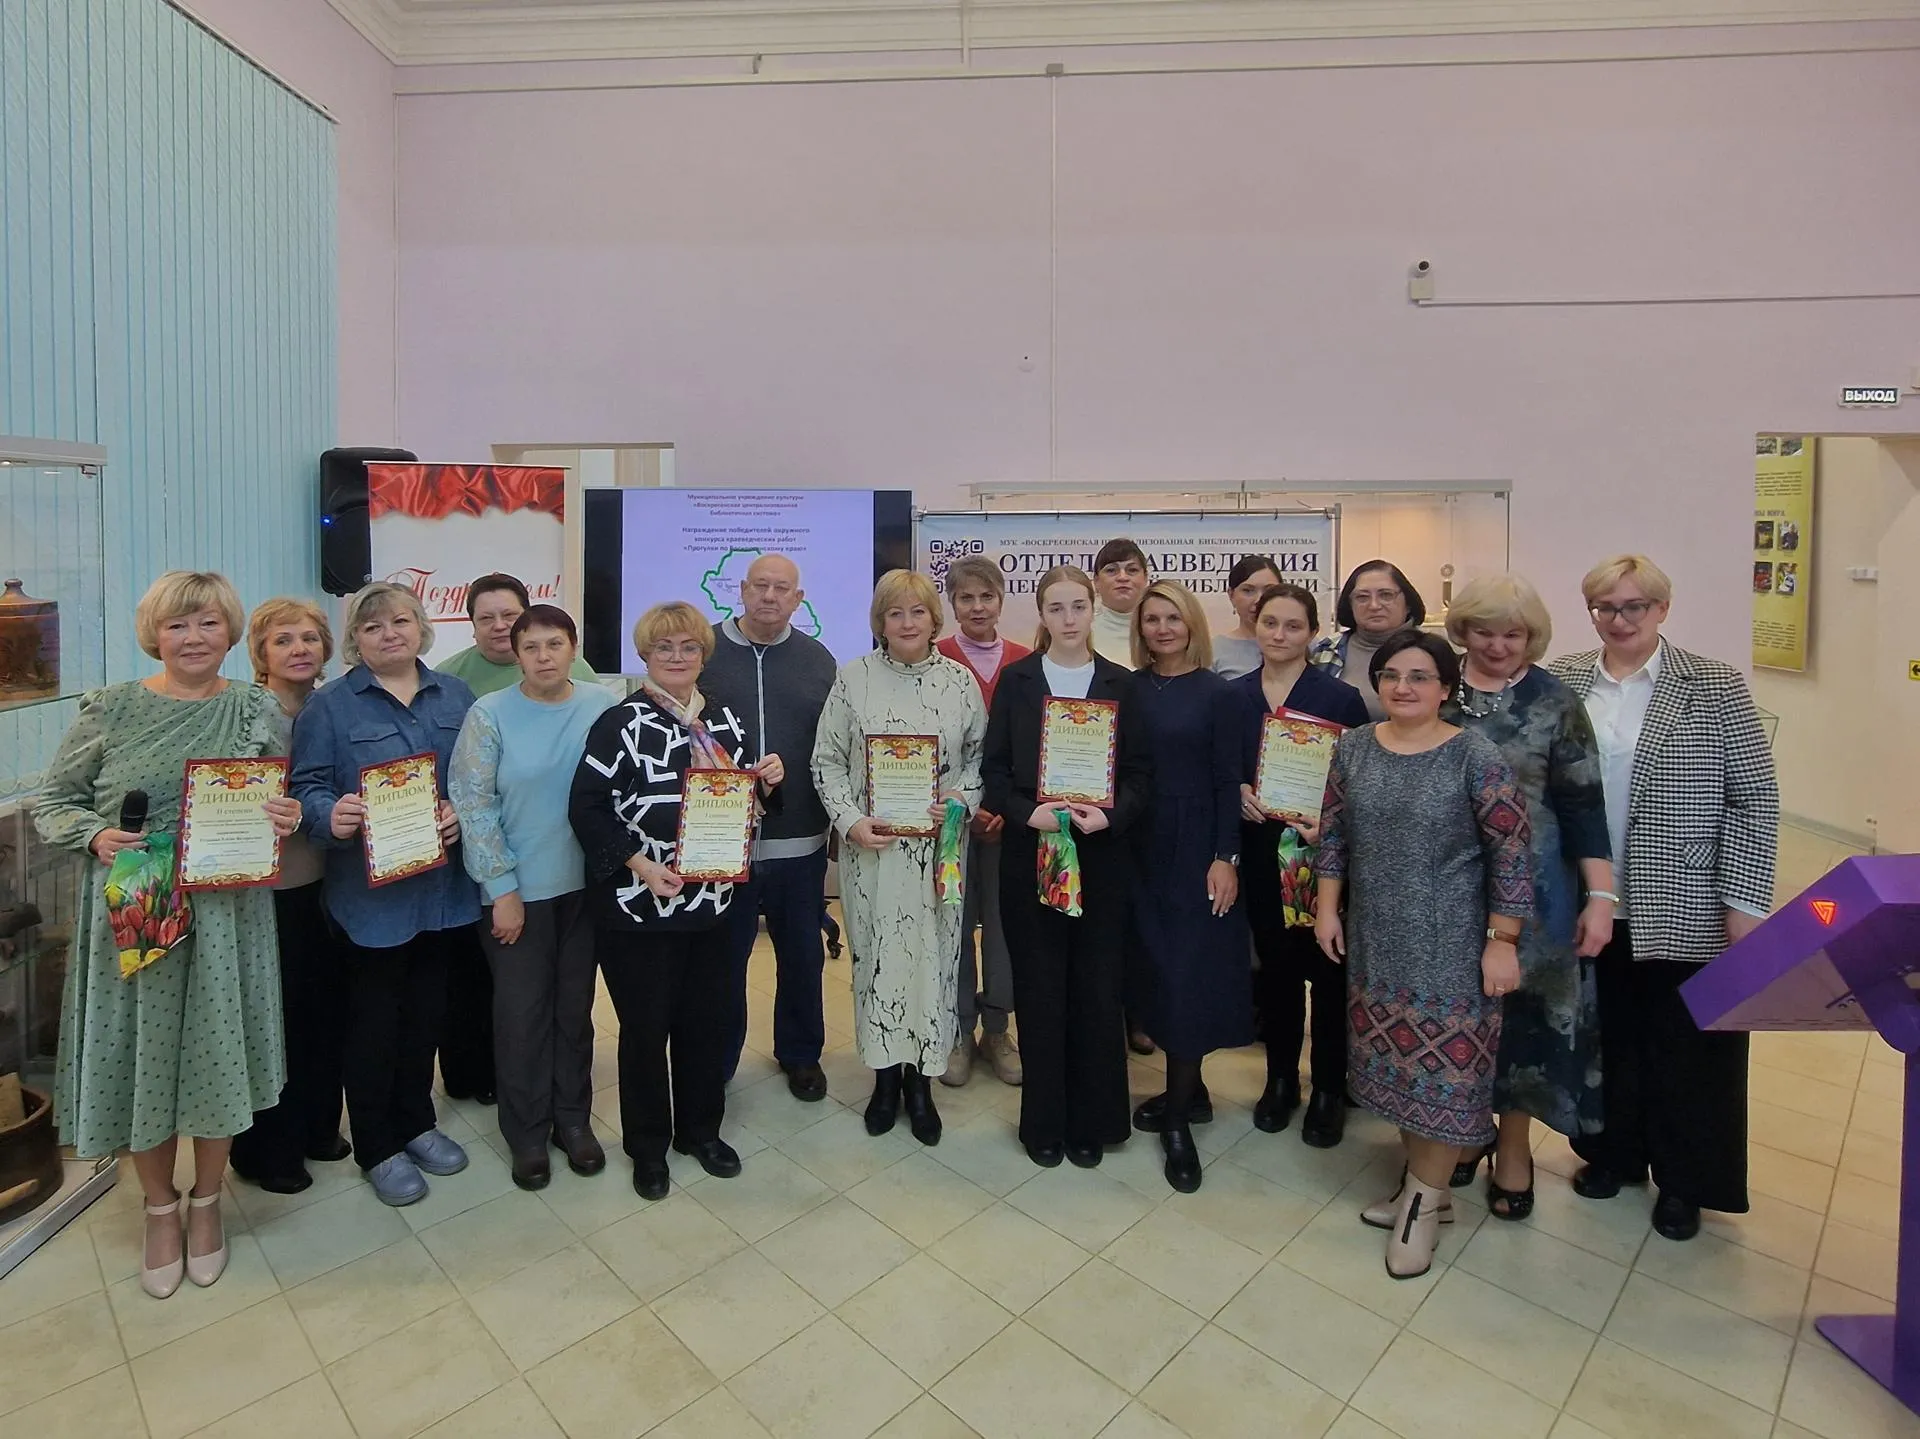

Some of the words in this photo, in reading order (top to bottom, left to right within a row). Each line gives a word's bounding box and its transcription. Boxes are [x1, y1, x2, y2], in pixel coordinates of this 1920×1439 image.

[1845, 390, 1896, 402] ВЫХОД
[729, 526, 772, 534] победителей
[1199, 538, 1270, 546] БИБЛИОТЕЧНАЯ
[999, 553, 1096, 576] ОТДЕЛ
[1053, 725, 1105, 737] ДИПЛОМ
[1271, 742, 1325, 760] ДИПЛОМ
[878, 761, 928, 770] ДИПЛОМ
[199, 791, 270, 805] ДИПЛОМ
[373, 784, 427, 806] ДИПЛОМ
[692, 798, 743, 809] ДИПЛОМ
